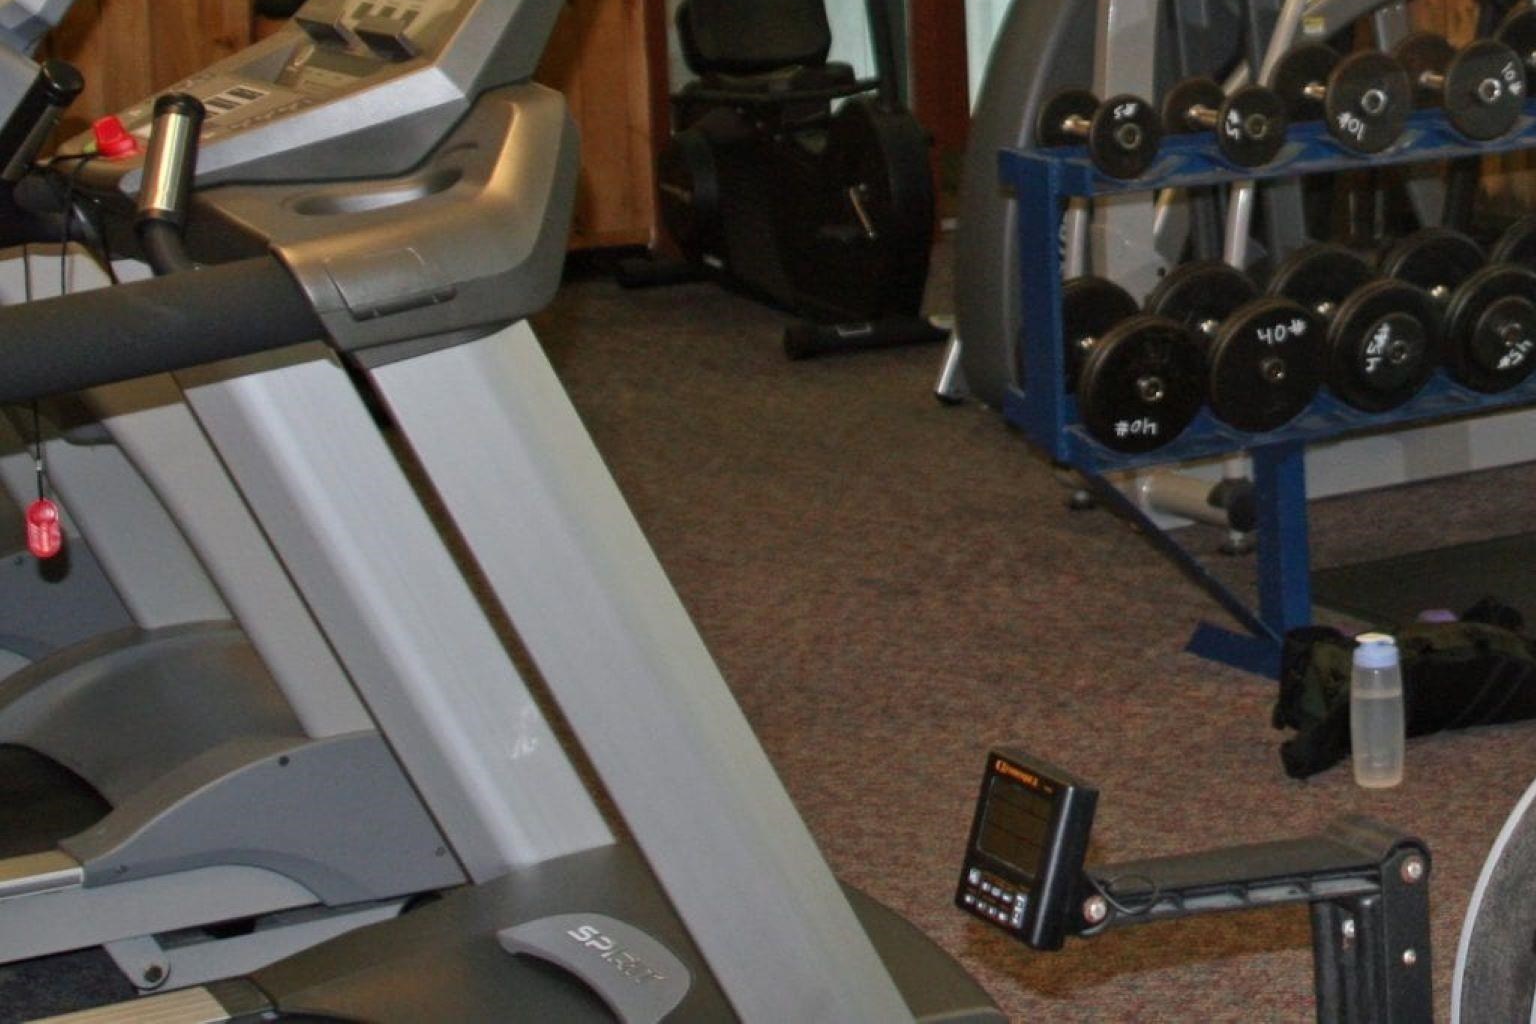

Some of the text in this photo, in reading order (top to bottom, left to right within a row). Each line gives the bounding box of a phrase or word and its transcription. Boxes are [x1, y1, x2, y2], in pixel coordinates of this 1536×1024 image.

[1501, 61, 1523, 97] 10#
[1336, 111, 1366, 141] 10#
[1256, 318, 1306, 345] 40#
[1115, 417, 1158, 437] 40#
